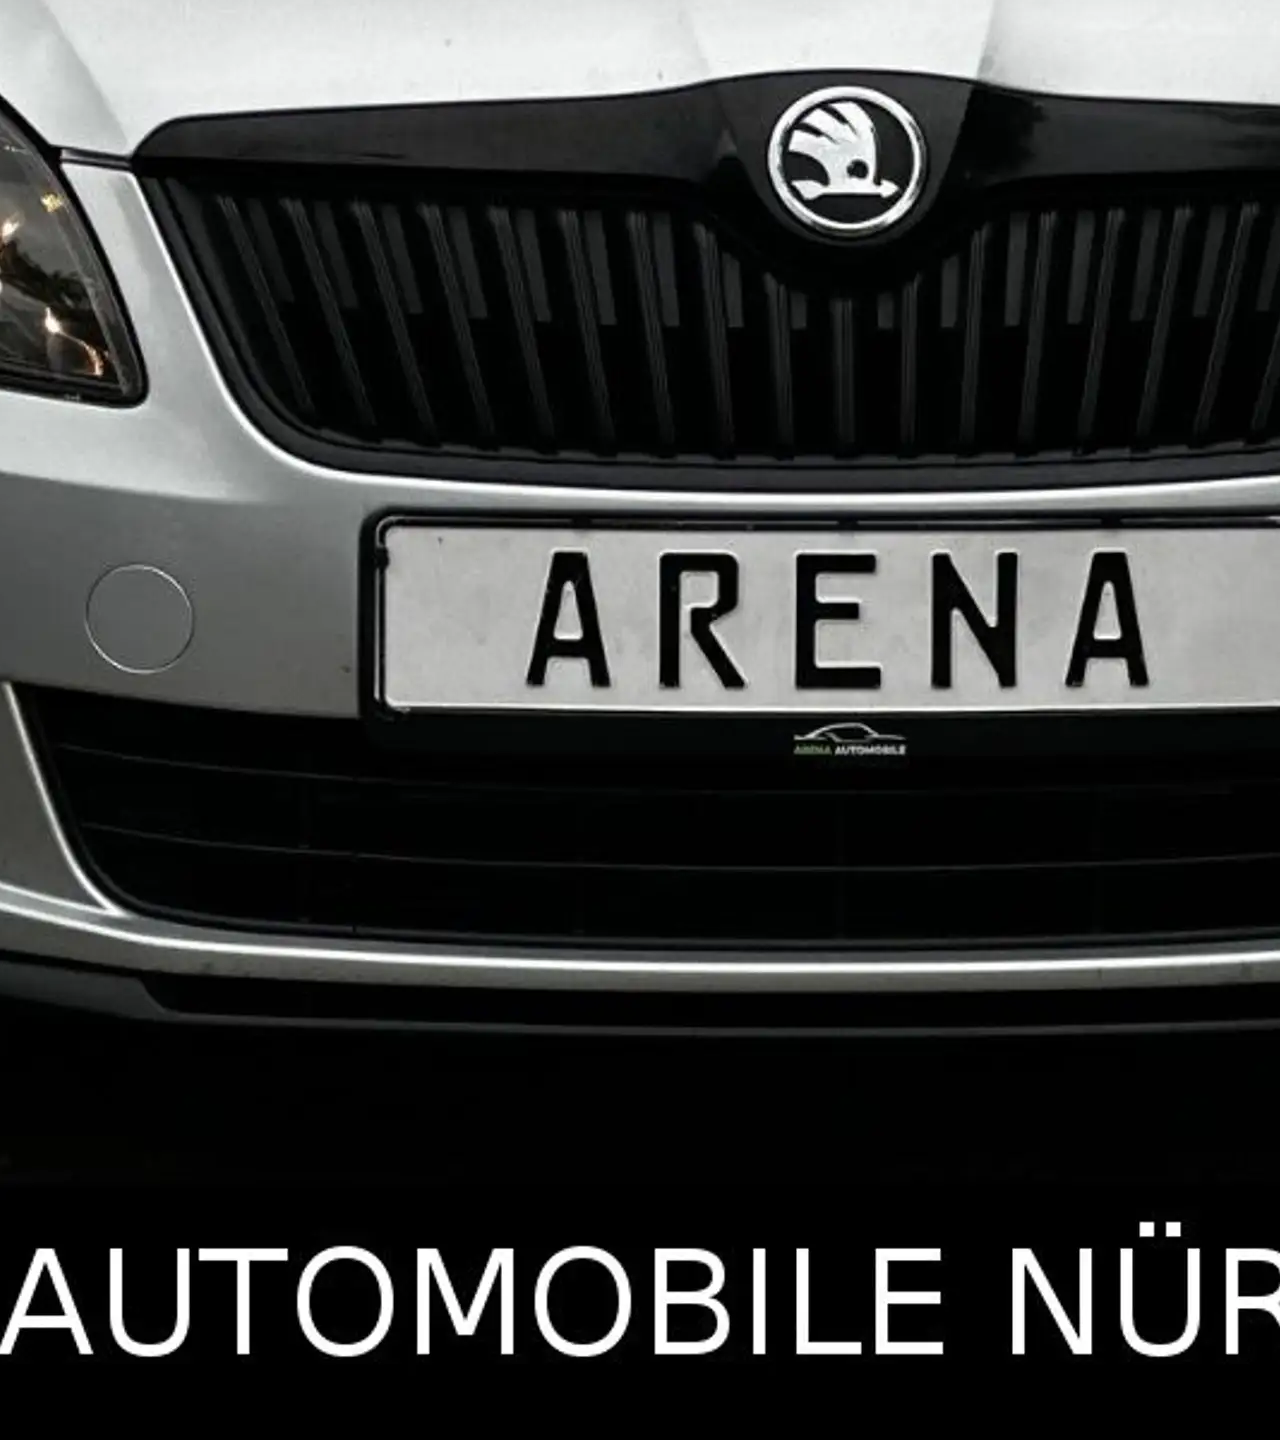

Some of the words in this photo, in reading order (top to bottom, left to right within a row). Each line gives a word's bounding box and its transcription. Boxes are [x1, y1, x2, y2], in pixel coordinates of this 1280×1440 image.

[526, 551, 1150, 691] ARENA
[793, 744, 832, 756] ARENA
[835, 744, 907, 756] AUTOMOBILE
